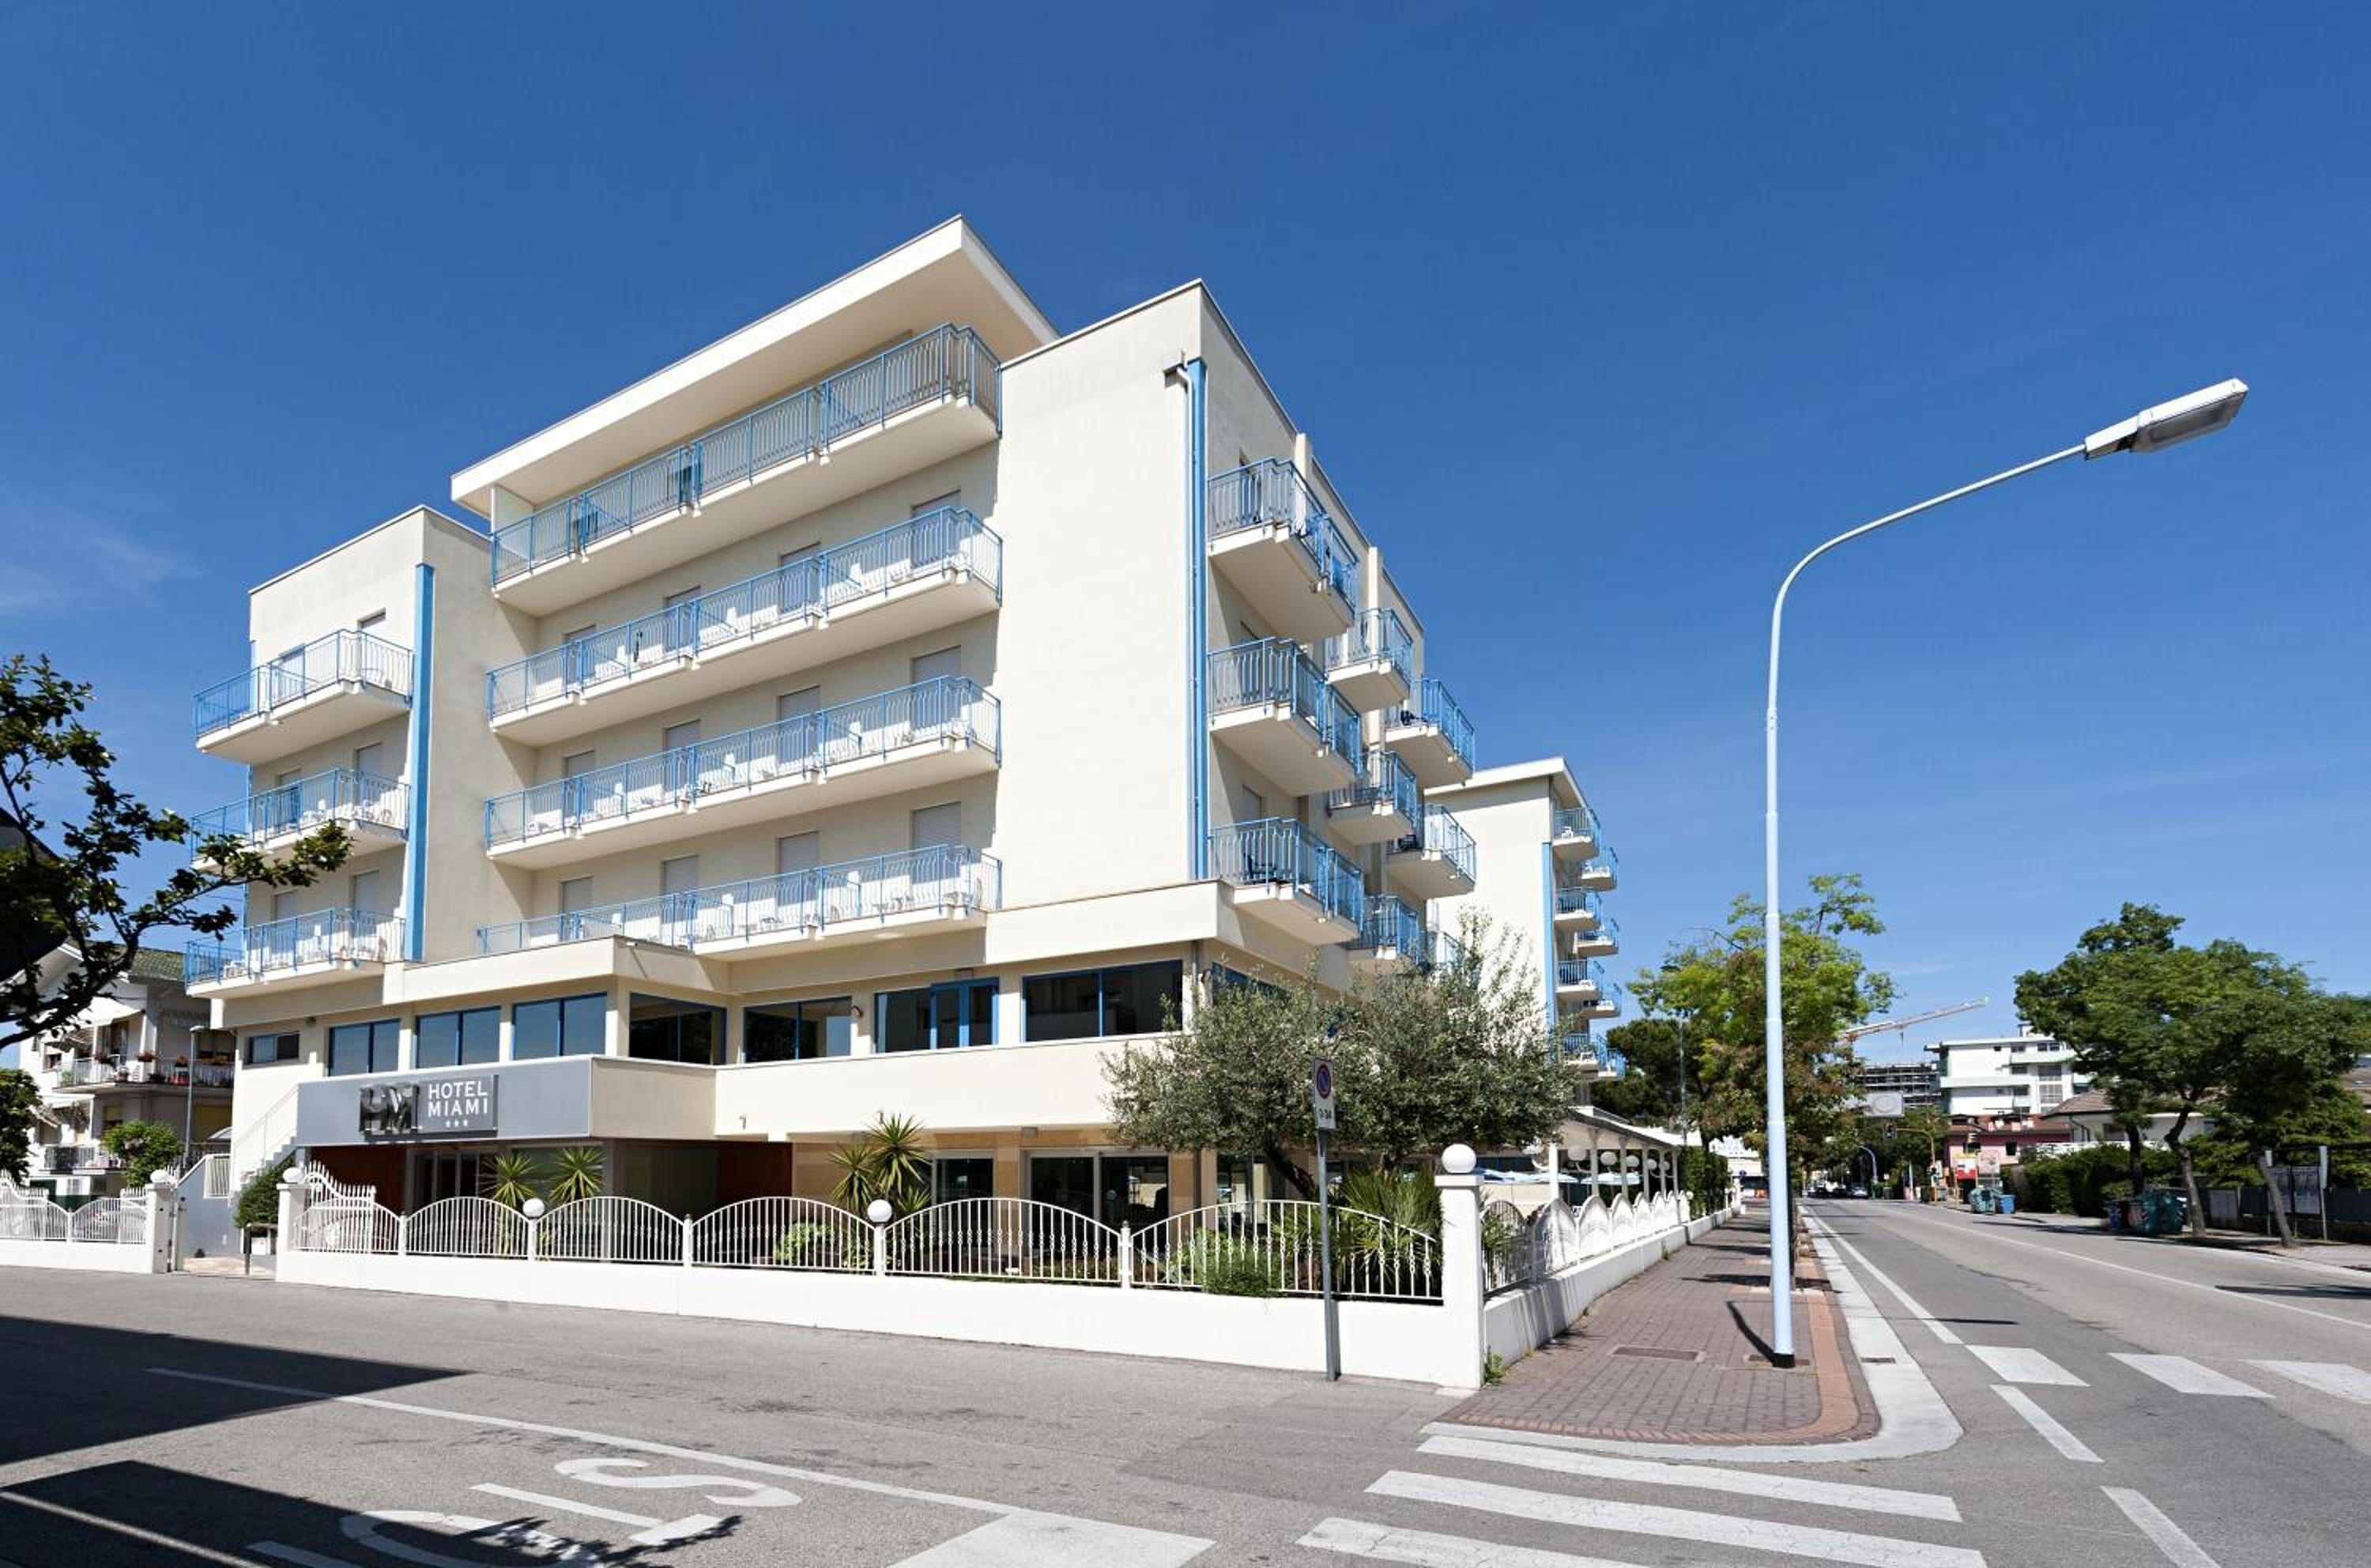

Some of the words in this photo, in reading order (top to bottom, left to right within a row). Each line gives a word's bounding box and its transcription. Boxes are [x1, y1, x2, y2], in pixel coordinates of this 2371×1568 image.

[428, 1080, 488, 1100] HOTEL
[428, 1098, 488, 1118] MIAMI
[246, 1457, 802, 1568] STO
